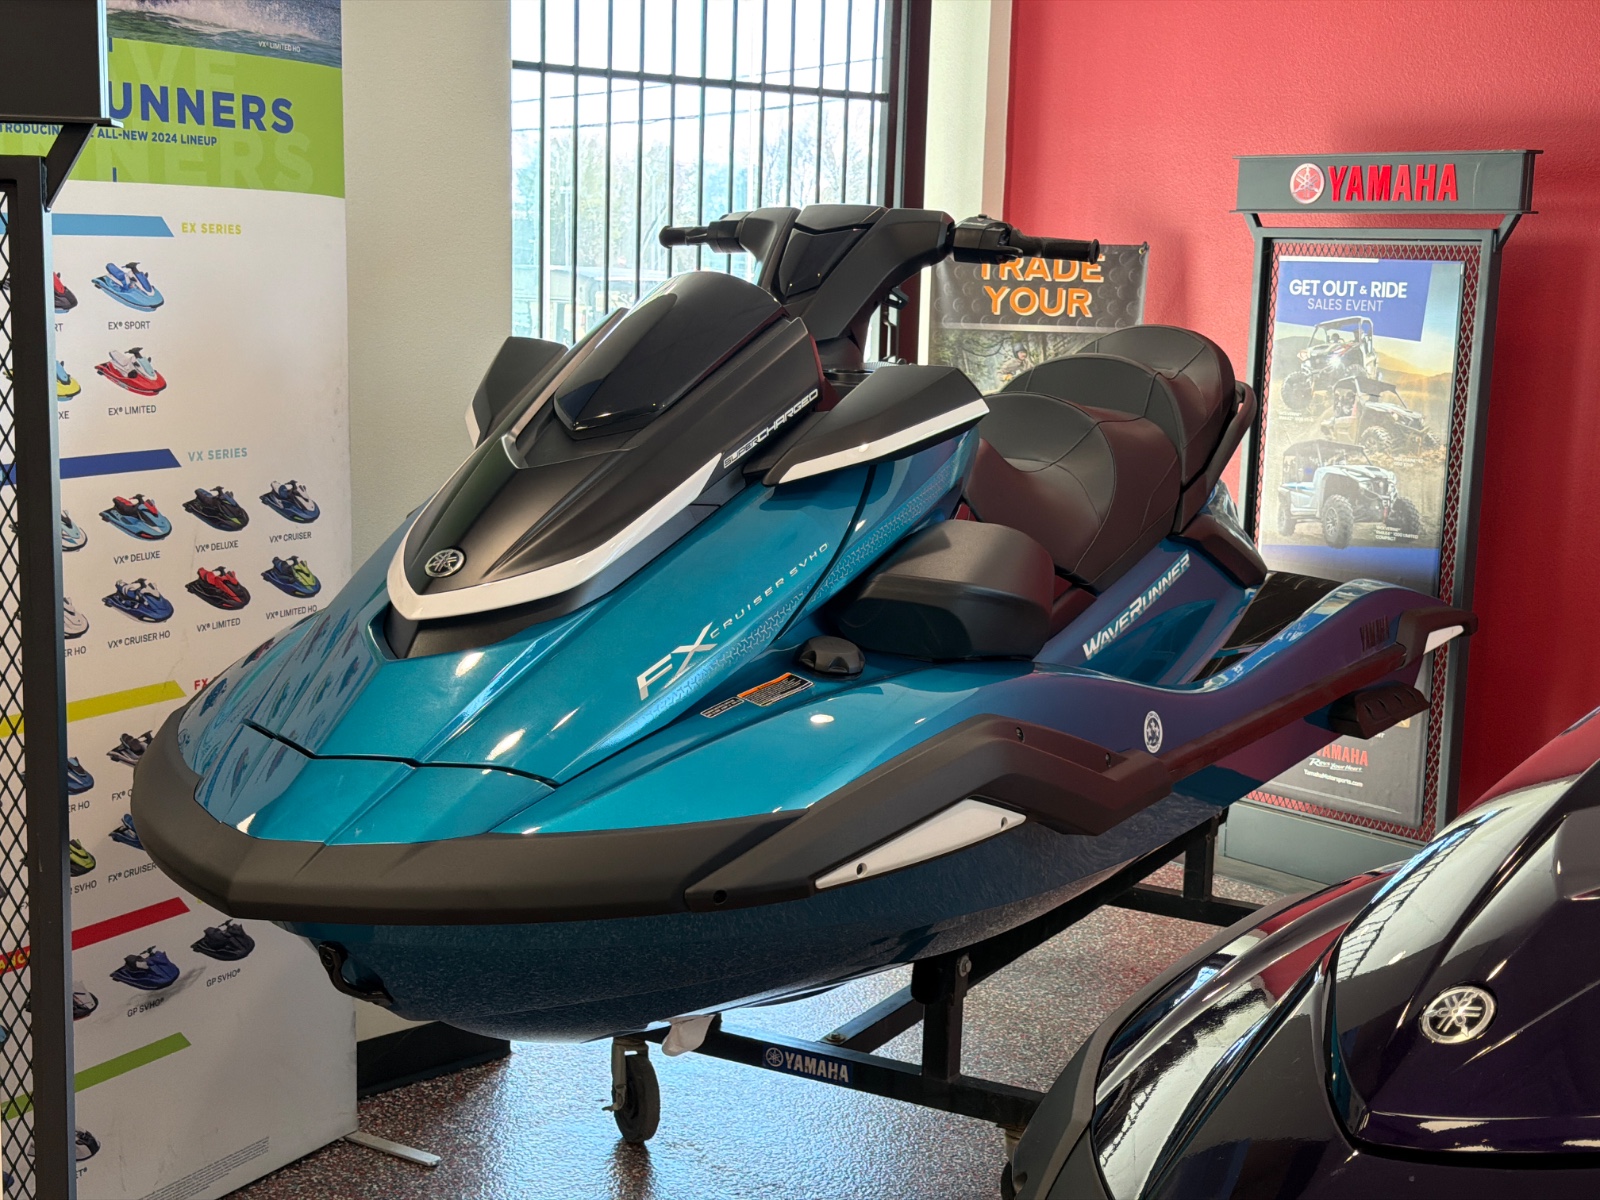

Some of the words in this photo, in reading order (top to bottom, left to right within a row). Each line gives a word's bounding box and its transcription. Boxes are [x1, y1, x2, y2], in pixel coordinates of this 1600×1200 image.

[293, 45, 301, 53] HO
[109, 81, 294, 134] UNNERS
[0, 123, 60, 136] TRODUCIN
[97, 128, 148, 142] ALL-NEW
[151, 132, 178, 144] 2024
[180, 134, 218, 146] LINEUP
[1327, 163, 1458, 202] YAMAHA
[181, 222, 196, 233] EX
[201, 223, 242, 235] SERIES
[1289, 279, 1320, 296] GET
[1322, 280, 1358, 297] OUT
[1359, 285, 1367, 295] &
[1370, 281, 1408, 298] RIDE
[983, 285, 1093, 318] YOUR
[1307, 298, 1342, 310] SALES
[1345, 299, 1384, 312] EVENT
[124, 321, 151, 330] SPORT
[124, 405, 157, 415] LIMITED
[723, 388, 819, 469] SUPERCHARGED
[188, 451, 204, 462] VX
[207, 447, 248, 460] SERIES
[283, 531, 312, 542] CRUISER
[210, 539, 239, 552] DELUXE
[130, 550, 161, 563] DELUXE
[280, 606, 306, 618] LIMITED
[307, 604, 318, 614] HO
[211, 617, 241, 631] LIMITED
[636, 621, 718, 701] FX
[709, 577, 785, 640] CRUISER
[789, 542, 829, 577] SVHO
[124, 632, 158, 646] CRUISER
[160, 630, 171, 640] HO
[74, 645, 87, 657] HO
[194, 678, 208, 691] FX
[78, 800, 90, 810] HO
[123, 862, 157, 879] CRUISER
[74, 879, 97, 894] SVHO
[206, 978, 217, 988] GP
[127, 1007, 138, 1018] GP
[784, 1051, 849, 1083] YAMAHA
